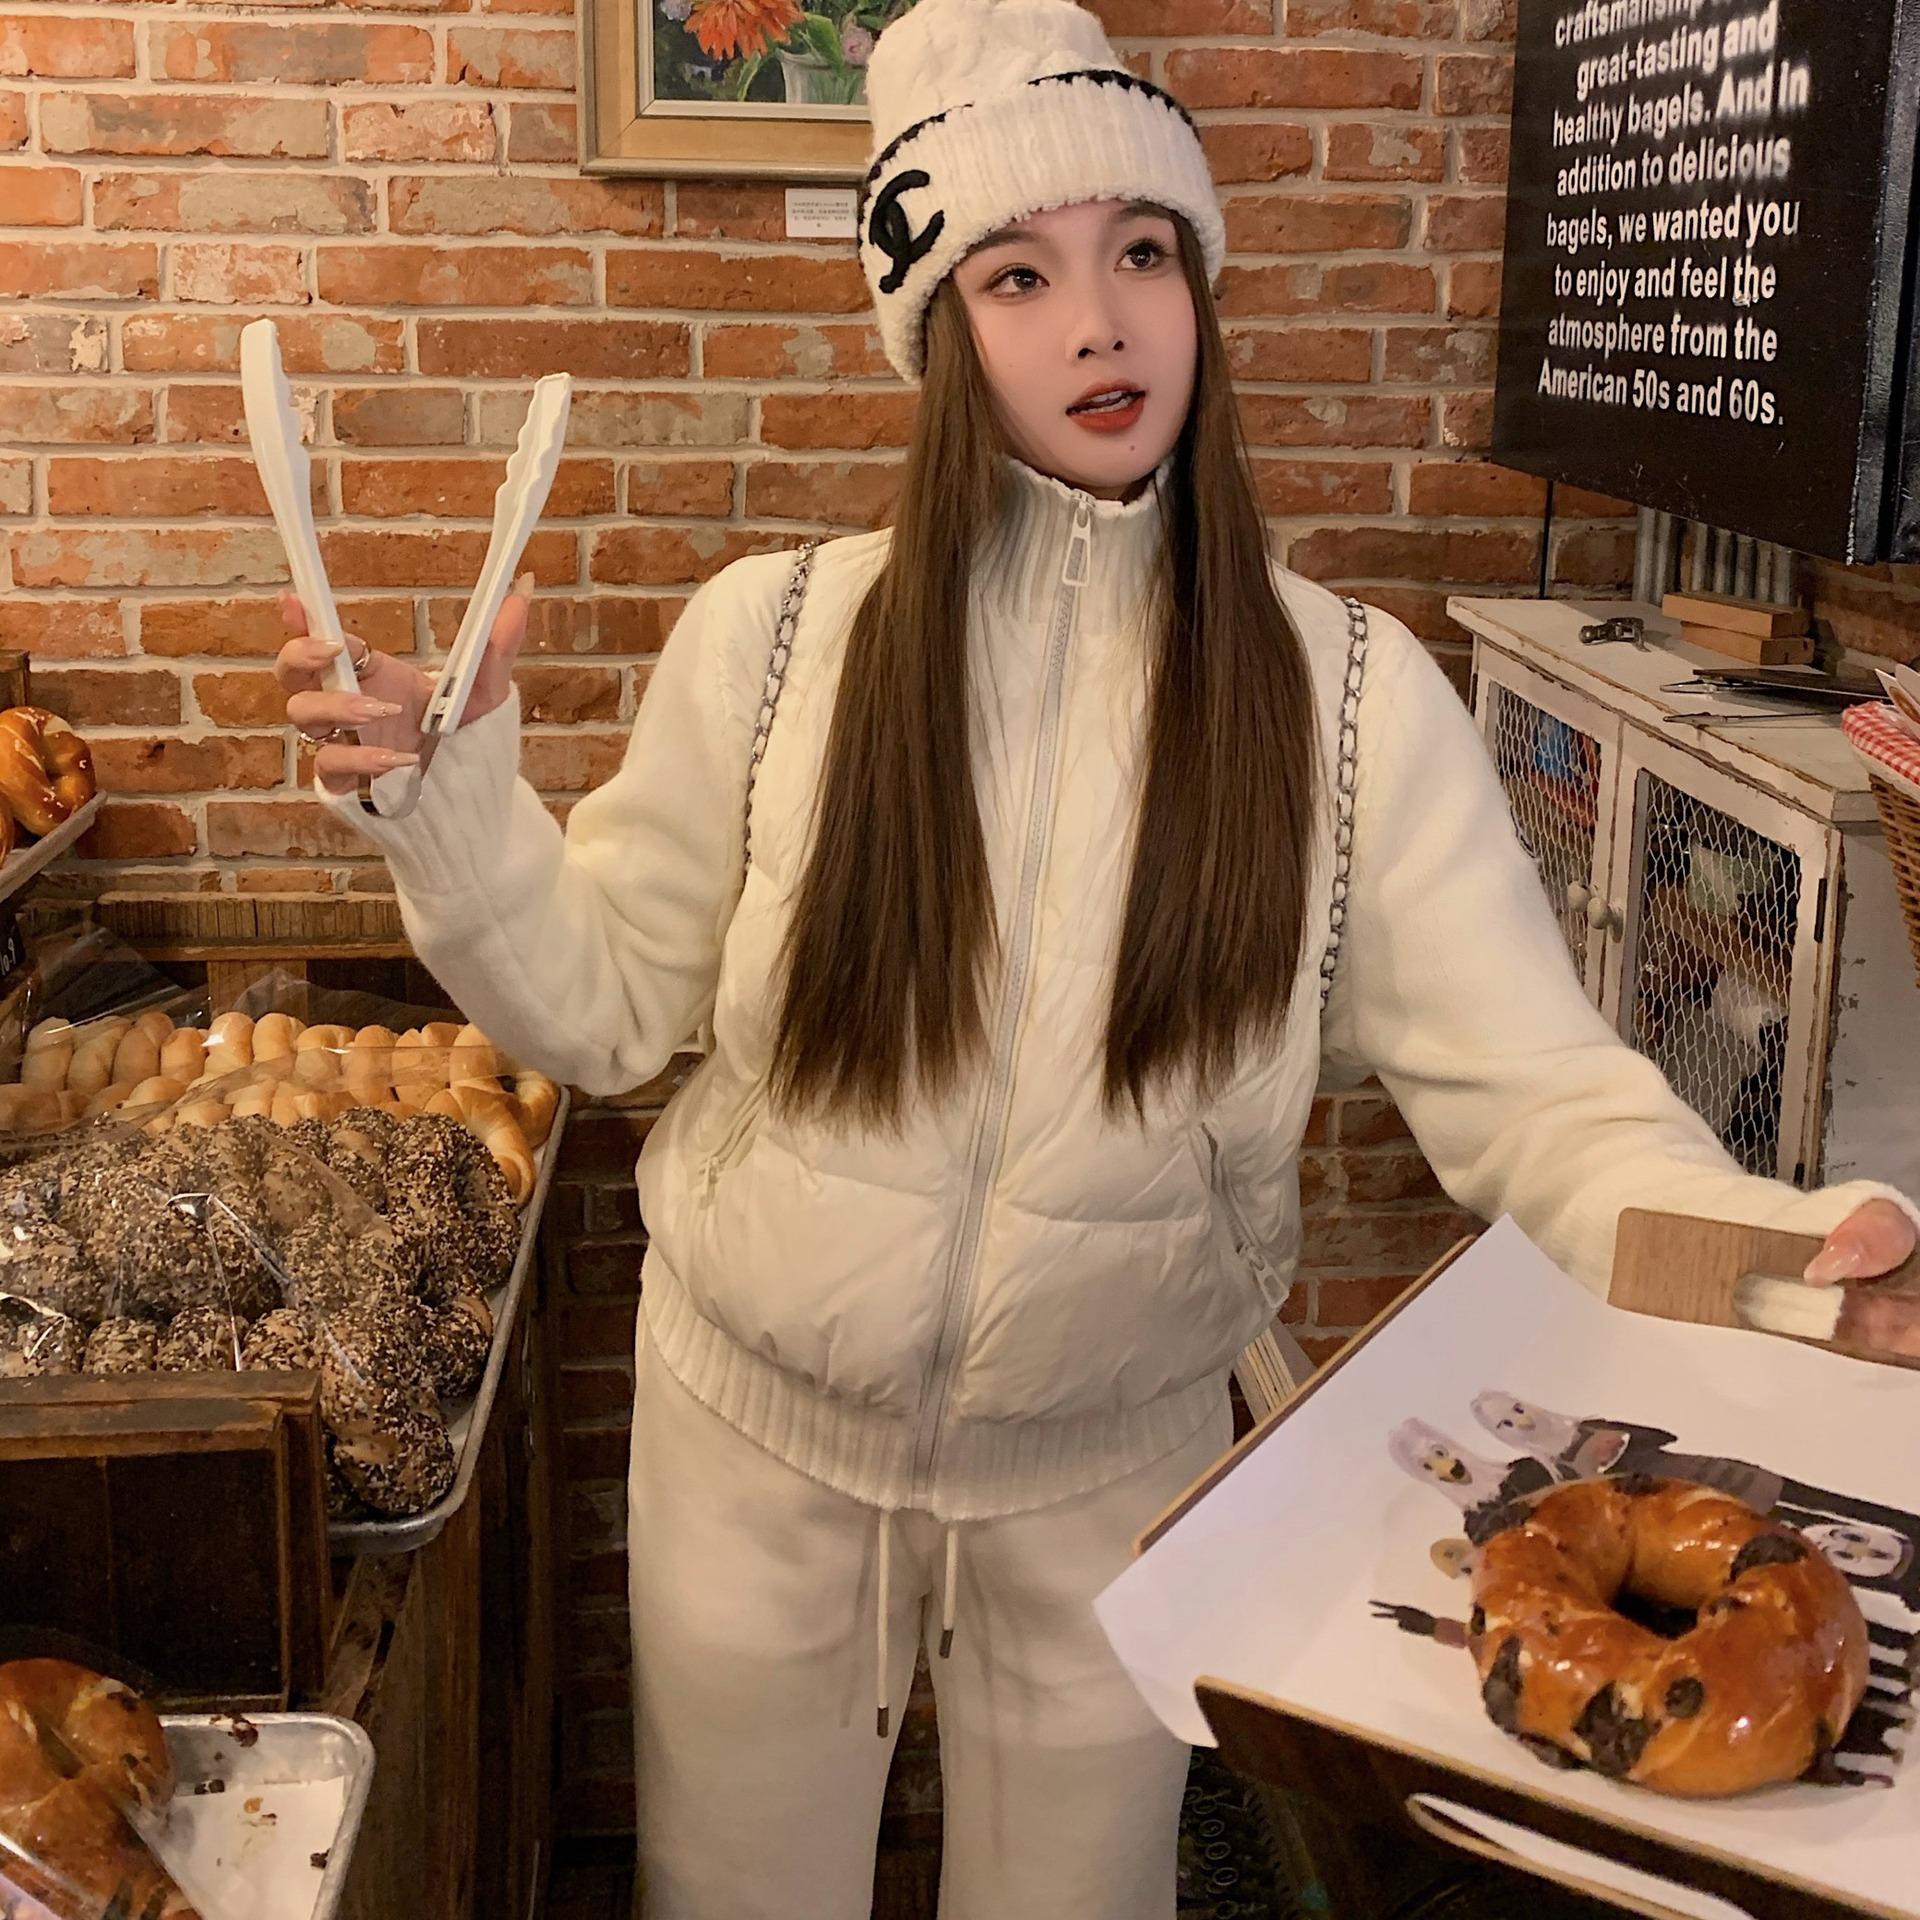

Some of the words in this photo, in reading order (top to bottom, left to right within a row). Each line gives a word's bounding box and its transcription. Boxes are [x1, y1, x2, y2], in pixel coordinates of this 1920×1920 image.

[1576, 25, 1720, 101] great-tasting
[1722, 0, 1779, 59] and
[1553, 101, 1624, 147] healthy
[1628, 81, 1711, 140] bagels.
[1715, 66, 1774, 119] And
[1557, 153, 1637, 196] addition
[1642, 148, 1664, 188] to
[1668, 134, 1791, 187] delicious
[1546, 206, 1613, 255] bagels,
[1618, 212, 1647, 243] we
[1652, 193, 1742, 242] wanted
[1745, 200, 1800, 249] you
[1555, 263, 1573, 297] to
[1576, 260, 1630, 306] enjoy
[1634, 257, 1676, 299] and
[1681, 256, 1727, 298] feel
[1732, 254, 1777, 306] the
[1548, 312, 1665, 361] atmosphere
[1670, 312, 1727, 358] from
[1734, 317, 1778, 361] the
[1537, 357, 1628, 405] American
[1632, 368, 1671, 410] 50s
[1676, 375, 1723, 417] and
[1729, 378, 1784, 426] 60s.
